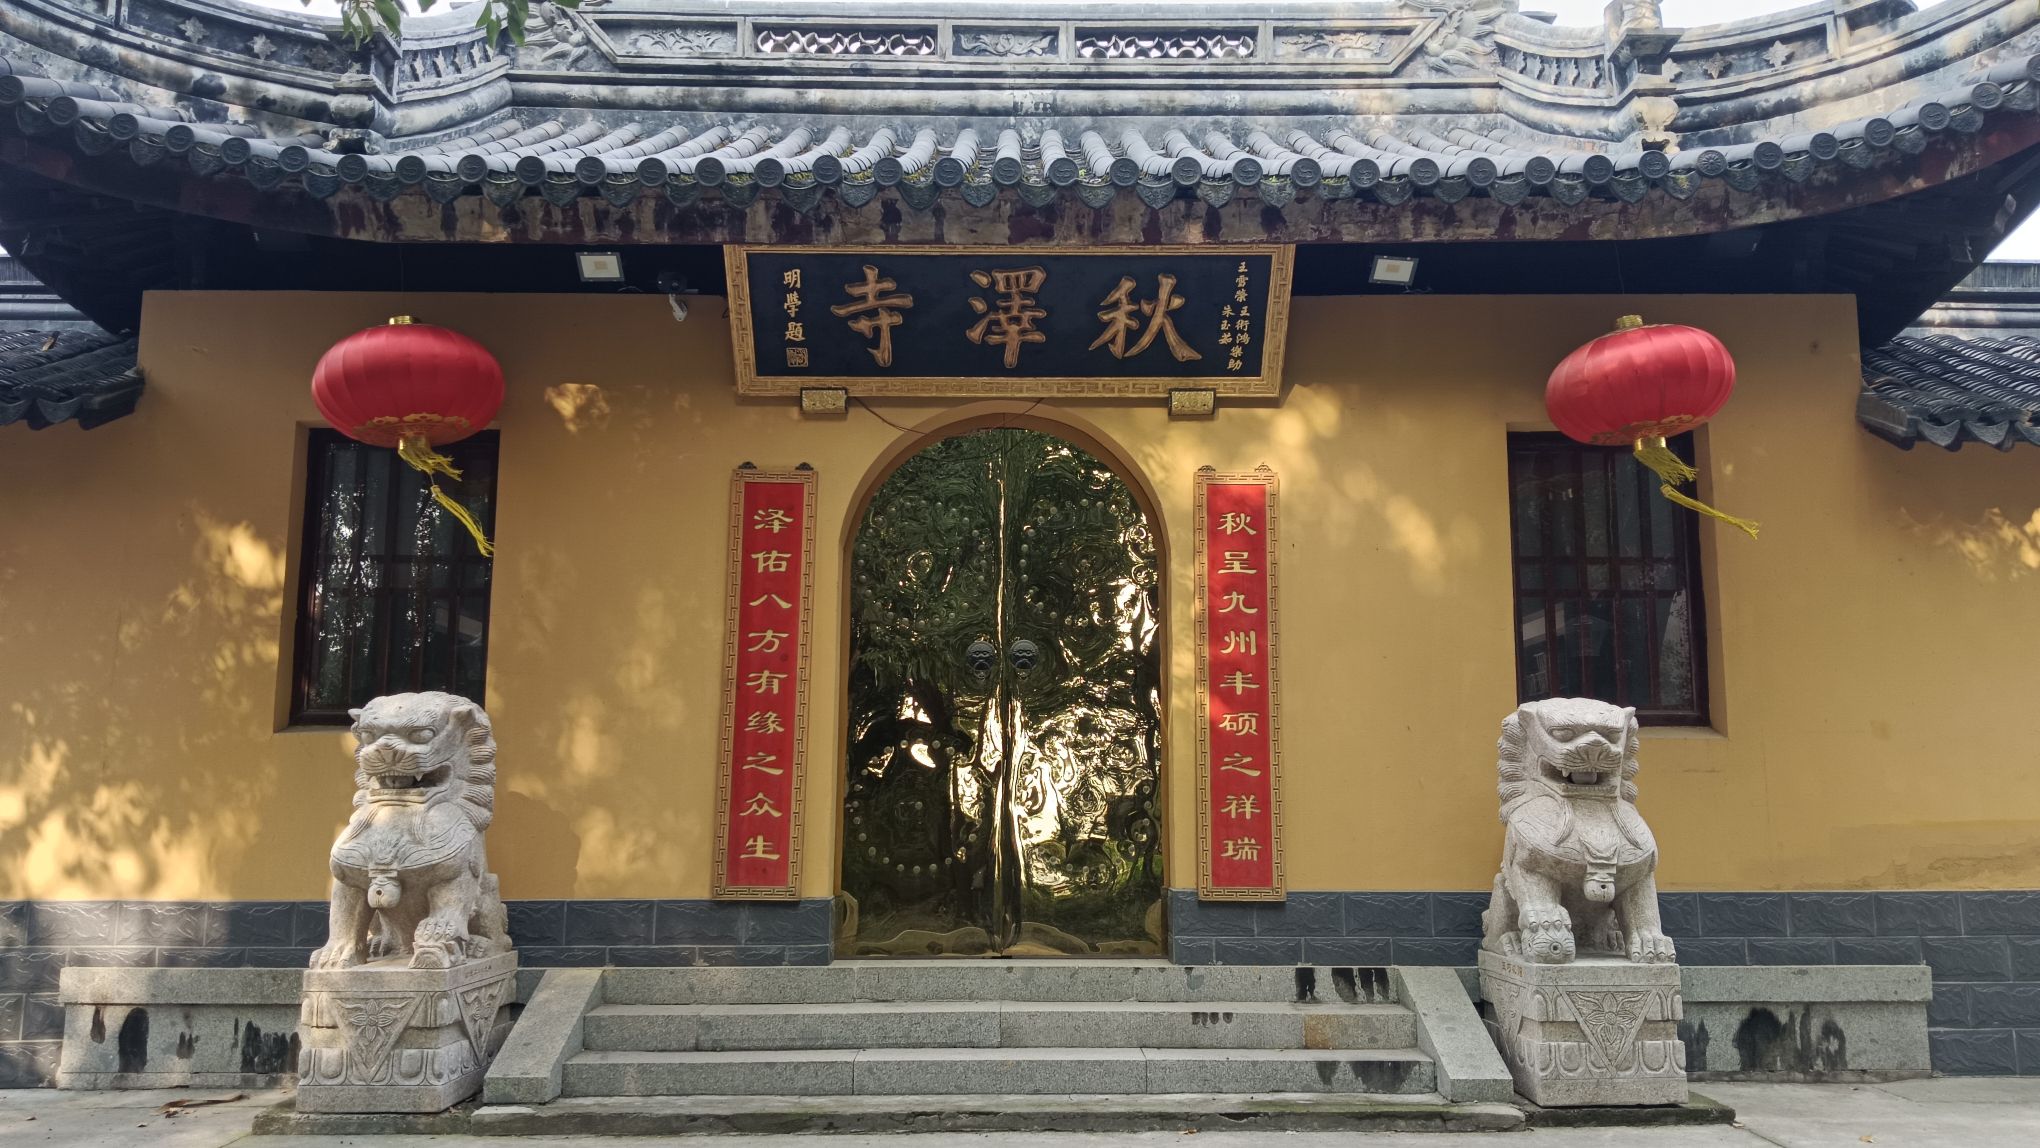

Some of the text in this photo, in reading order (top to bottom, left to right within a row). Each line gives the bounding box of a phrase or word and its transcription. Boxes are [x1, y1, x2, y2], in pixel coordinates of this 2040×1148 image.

[740, 508, 794, 861] 泽佑八方有缘之众生
[1216, 511, 1263, 862] 秋呈九州丰硕之祥瑞
